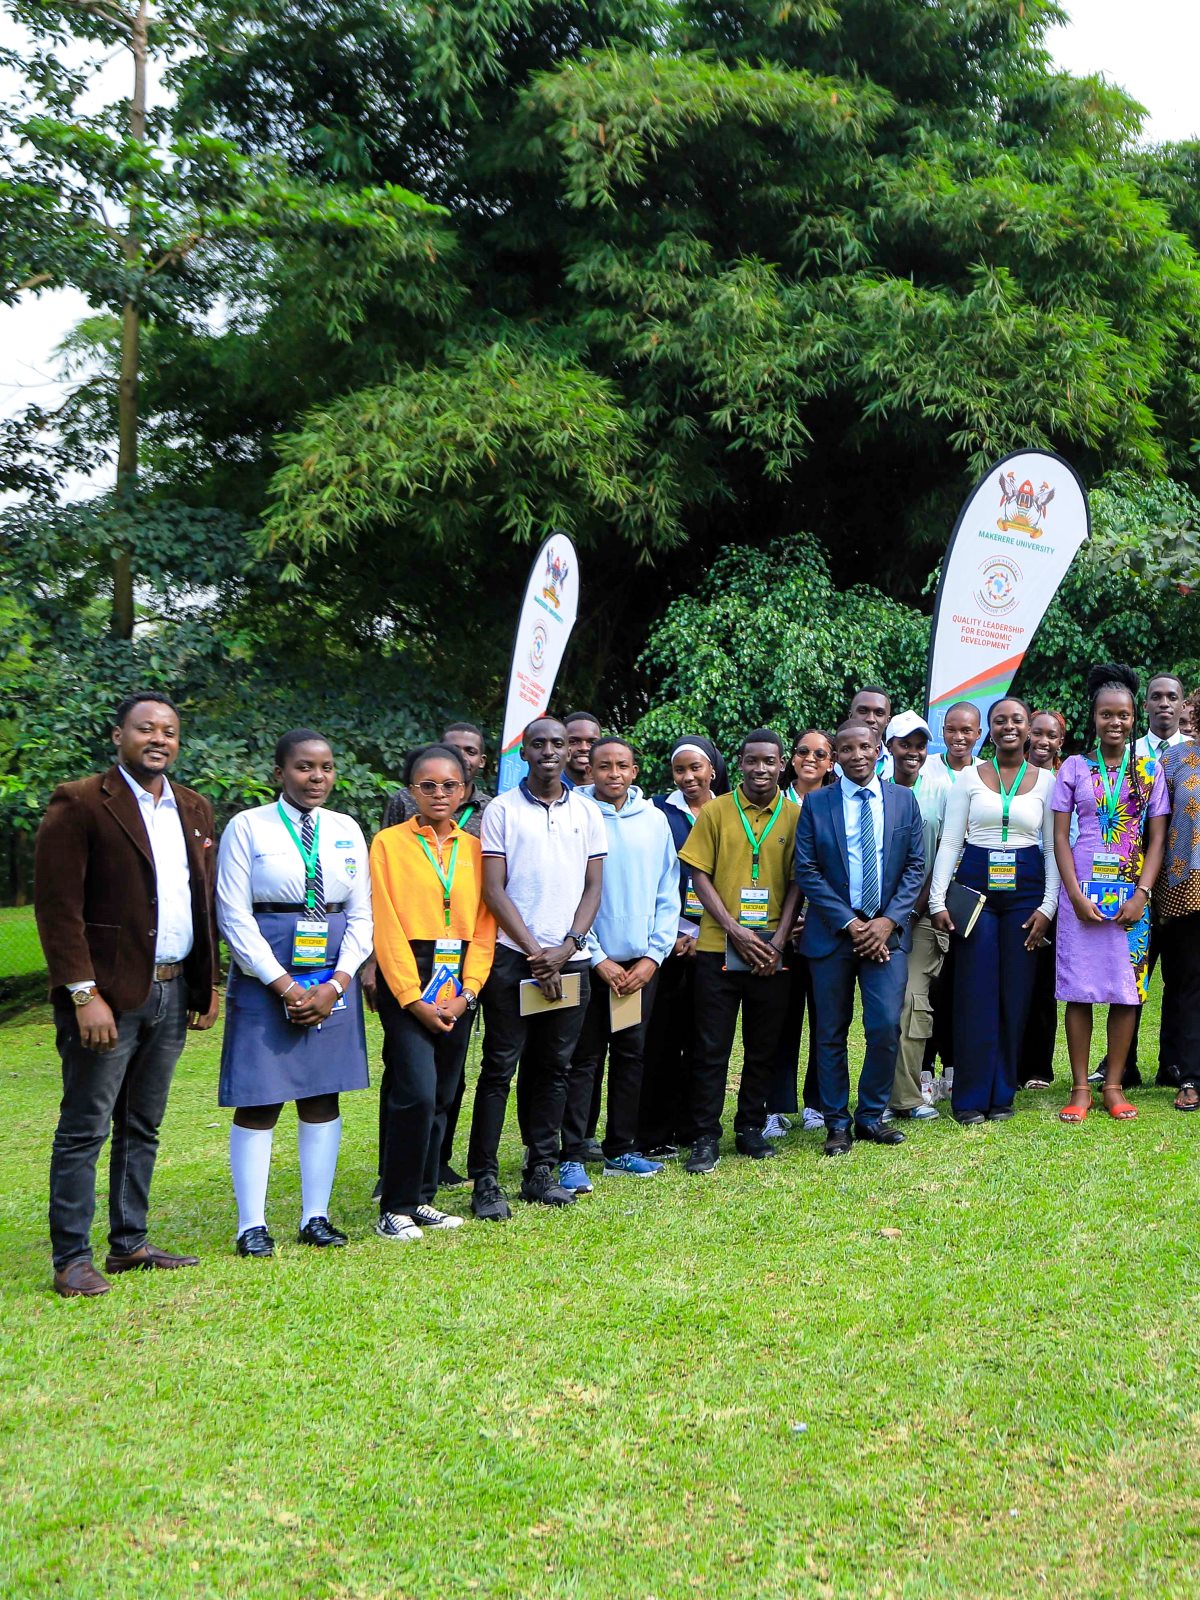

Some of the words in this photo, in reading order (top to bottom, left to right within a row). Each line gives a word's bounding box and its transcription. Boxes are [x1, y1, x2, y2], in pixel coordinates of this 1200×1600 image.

[978, 530, 1016, 545] MAKERERE
[1016, 540, 1055, 554] UNIVERSITY
[952, 614, 982, 626] QUALITY
[982, 620, 1025, 634] LEADERSHIP
[960, 635, 1010, 651] DEVELOPMENT
[961, 626, 975, 635] FOR
[976, 629, 1013, 642] ECONOMIC
